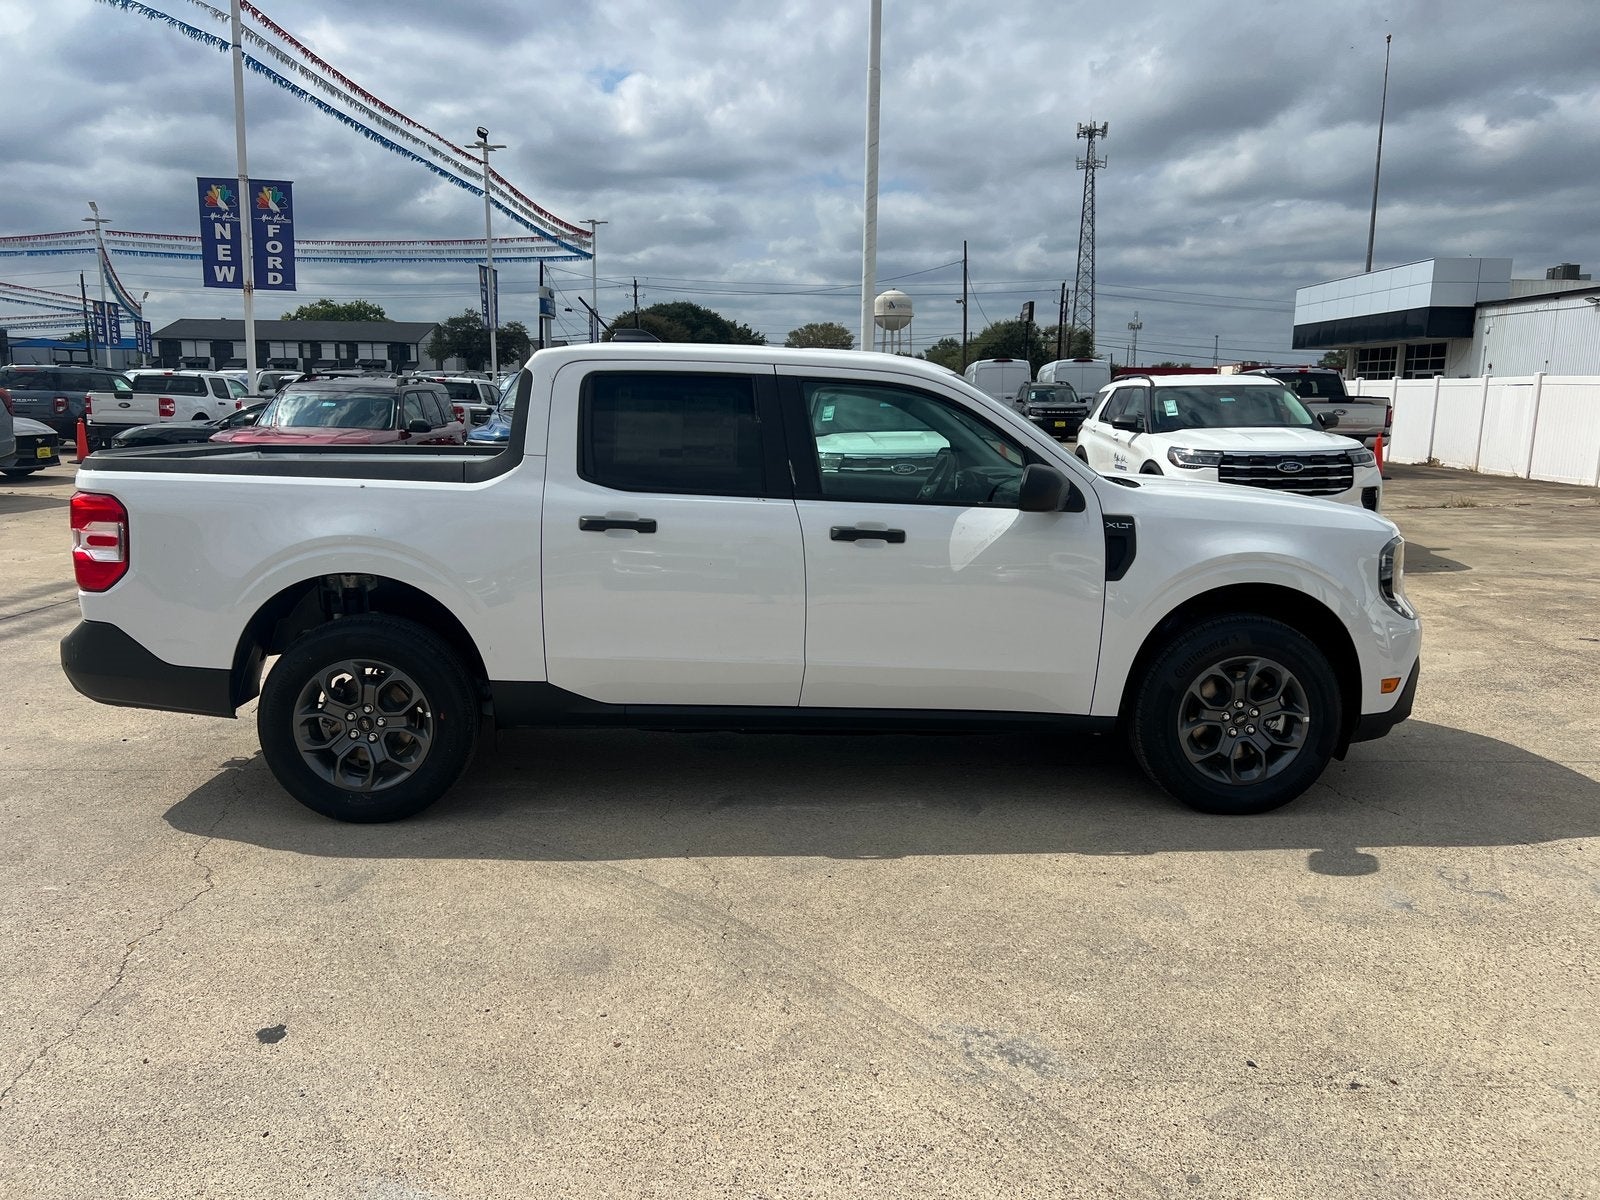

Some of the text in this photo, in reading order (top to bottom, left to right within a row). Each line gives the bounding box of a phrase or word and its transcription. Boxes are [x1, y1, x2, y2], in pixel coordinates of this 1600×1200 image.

[213, 222, 236, 283] NEW
[265, 224, 284, 285] FORD
[1105, 521, 1134, 529] XLT
